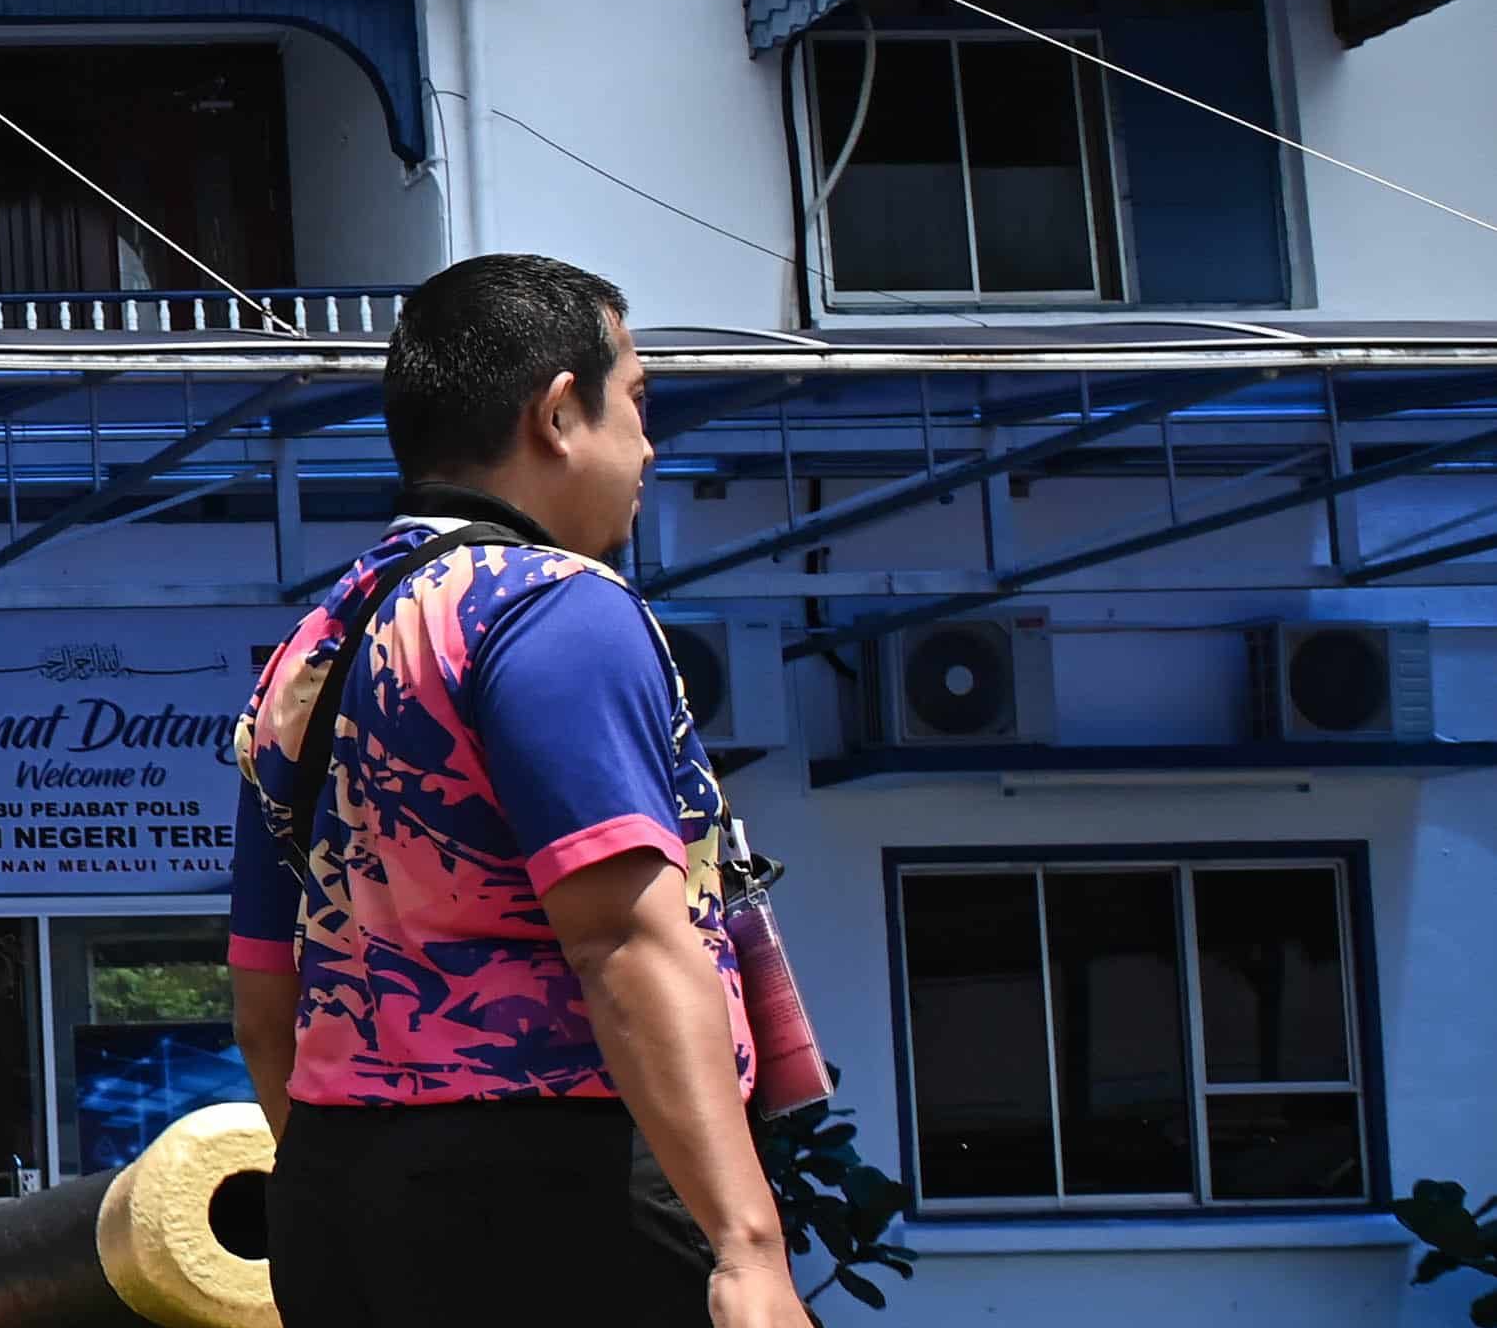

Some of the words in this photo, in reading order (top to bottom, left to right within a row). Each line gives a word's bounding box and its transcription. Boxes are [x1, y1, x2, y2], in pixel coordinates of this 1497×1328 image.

[66, 697, 239, 765] Datang
[15, 758, 135, 791] Welcome
[140, 760, 167, 788] to
[30, 800, 130, 818] PEJABAT
[135, 800, 201, 817] POLIS
[12, 825, 138, 850] NEGERI
[58, 858, 158, 873] MELALUI
